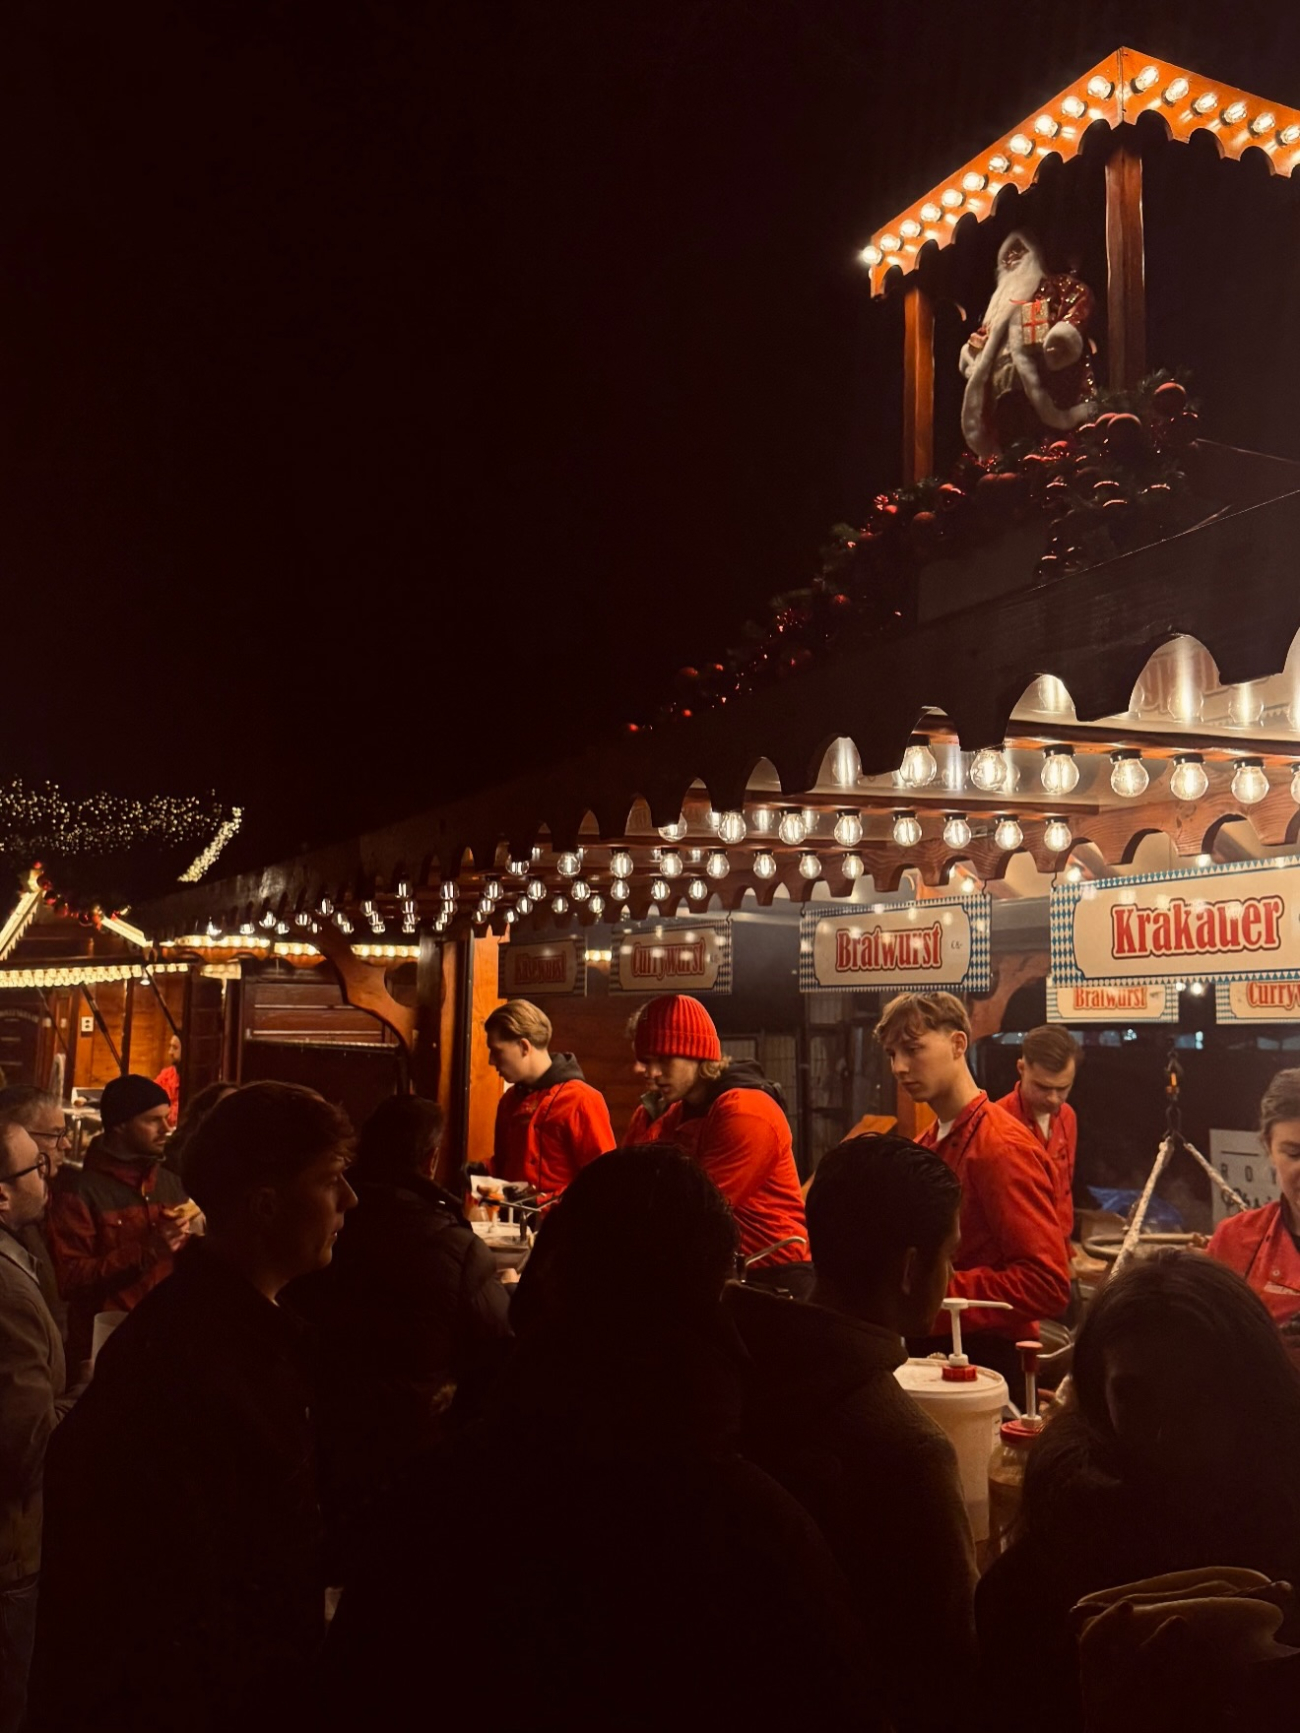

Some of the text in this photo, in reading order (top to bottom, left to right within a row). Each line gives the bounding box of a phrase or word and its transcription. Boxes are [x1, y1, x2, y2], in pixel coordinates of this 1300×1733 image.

[836, 922, 942, 971] Bratwurst
[1112, 897, 1283, 957] Krakauer
[632, 938, 705, 979] Currywurst
[1073, 986, 1147, 1009] Bratwurst
